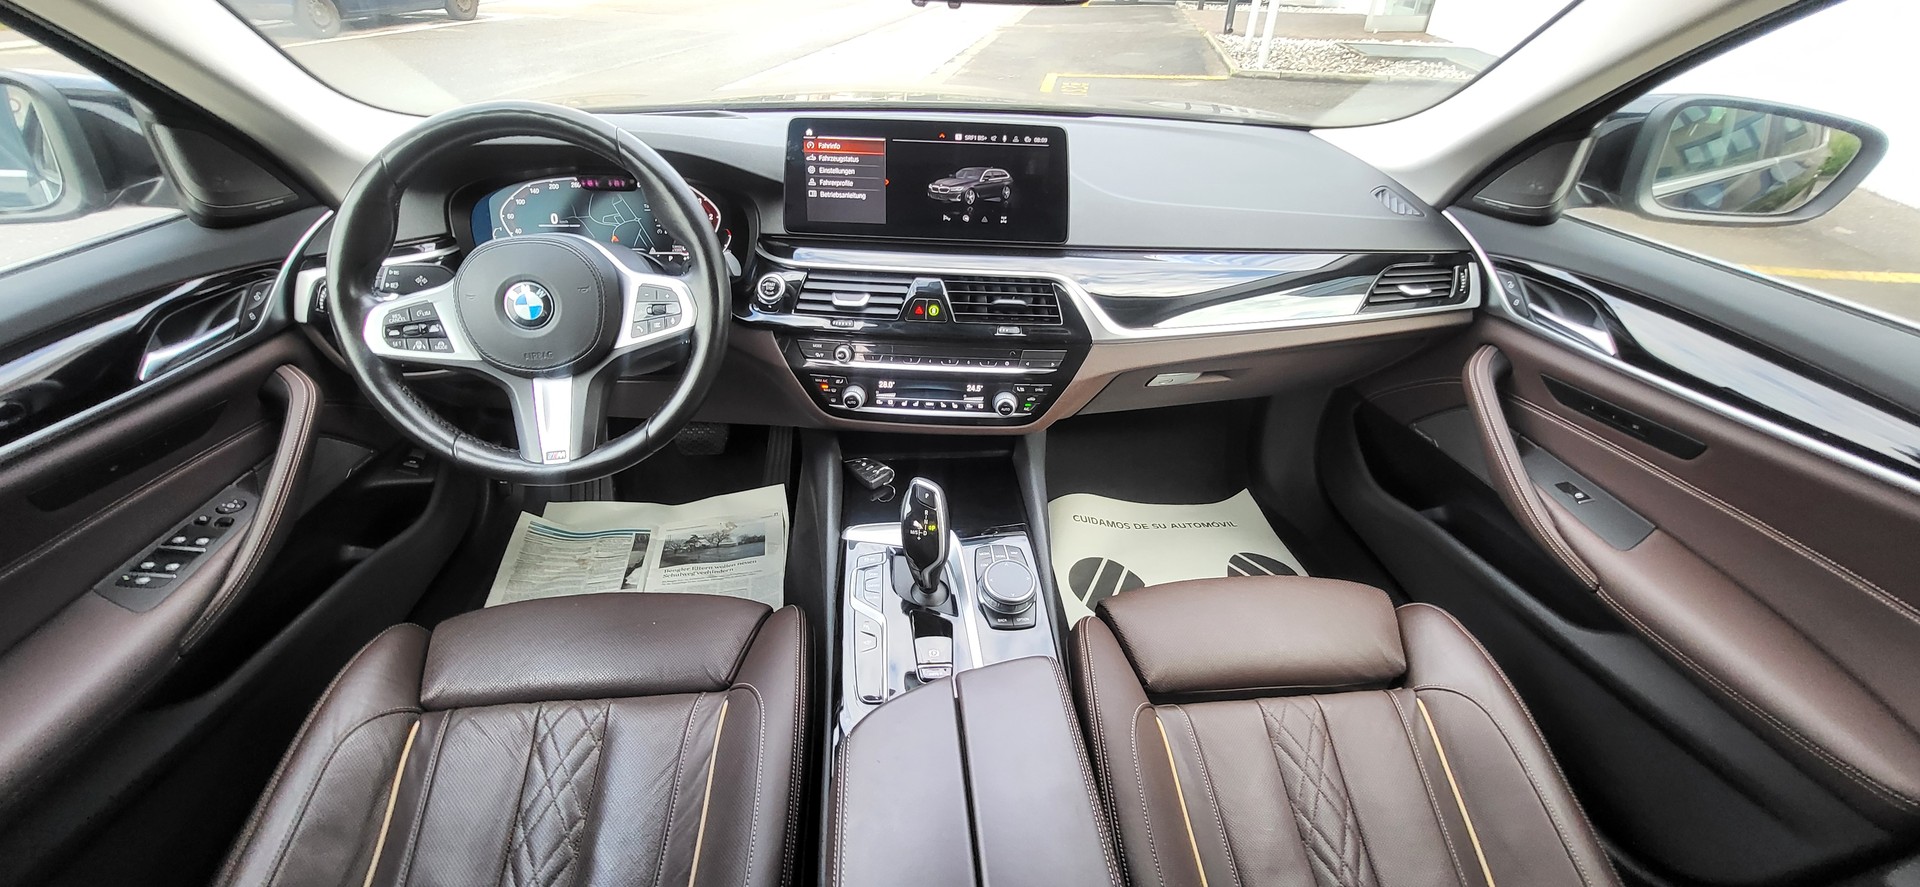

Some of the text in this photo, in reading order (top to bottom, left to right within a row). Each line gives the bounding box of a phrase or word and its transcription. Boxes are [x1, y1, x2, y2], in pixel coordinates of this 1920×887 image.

[818, 142, 841, 150] Fahrinfo
[818, 154, 860, 163] Fahrzeugstatus
[819, 166, 856, 176] Einstellungen
[819, 178, 854, 187] Fahrerprofile
[820, 190, 867, 201] Betriebsanleitung
[516, 198, 526, 206] 100
[550, 212, 559, 225] 0
[709, 213, 714, 221] 2
[1072, 514, 1131, 530] CUIDAMOS
